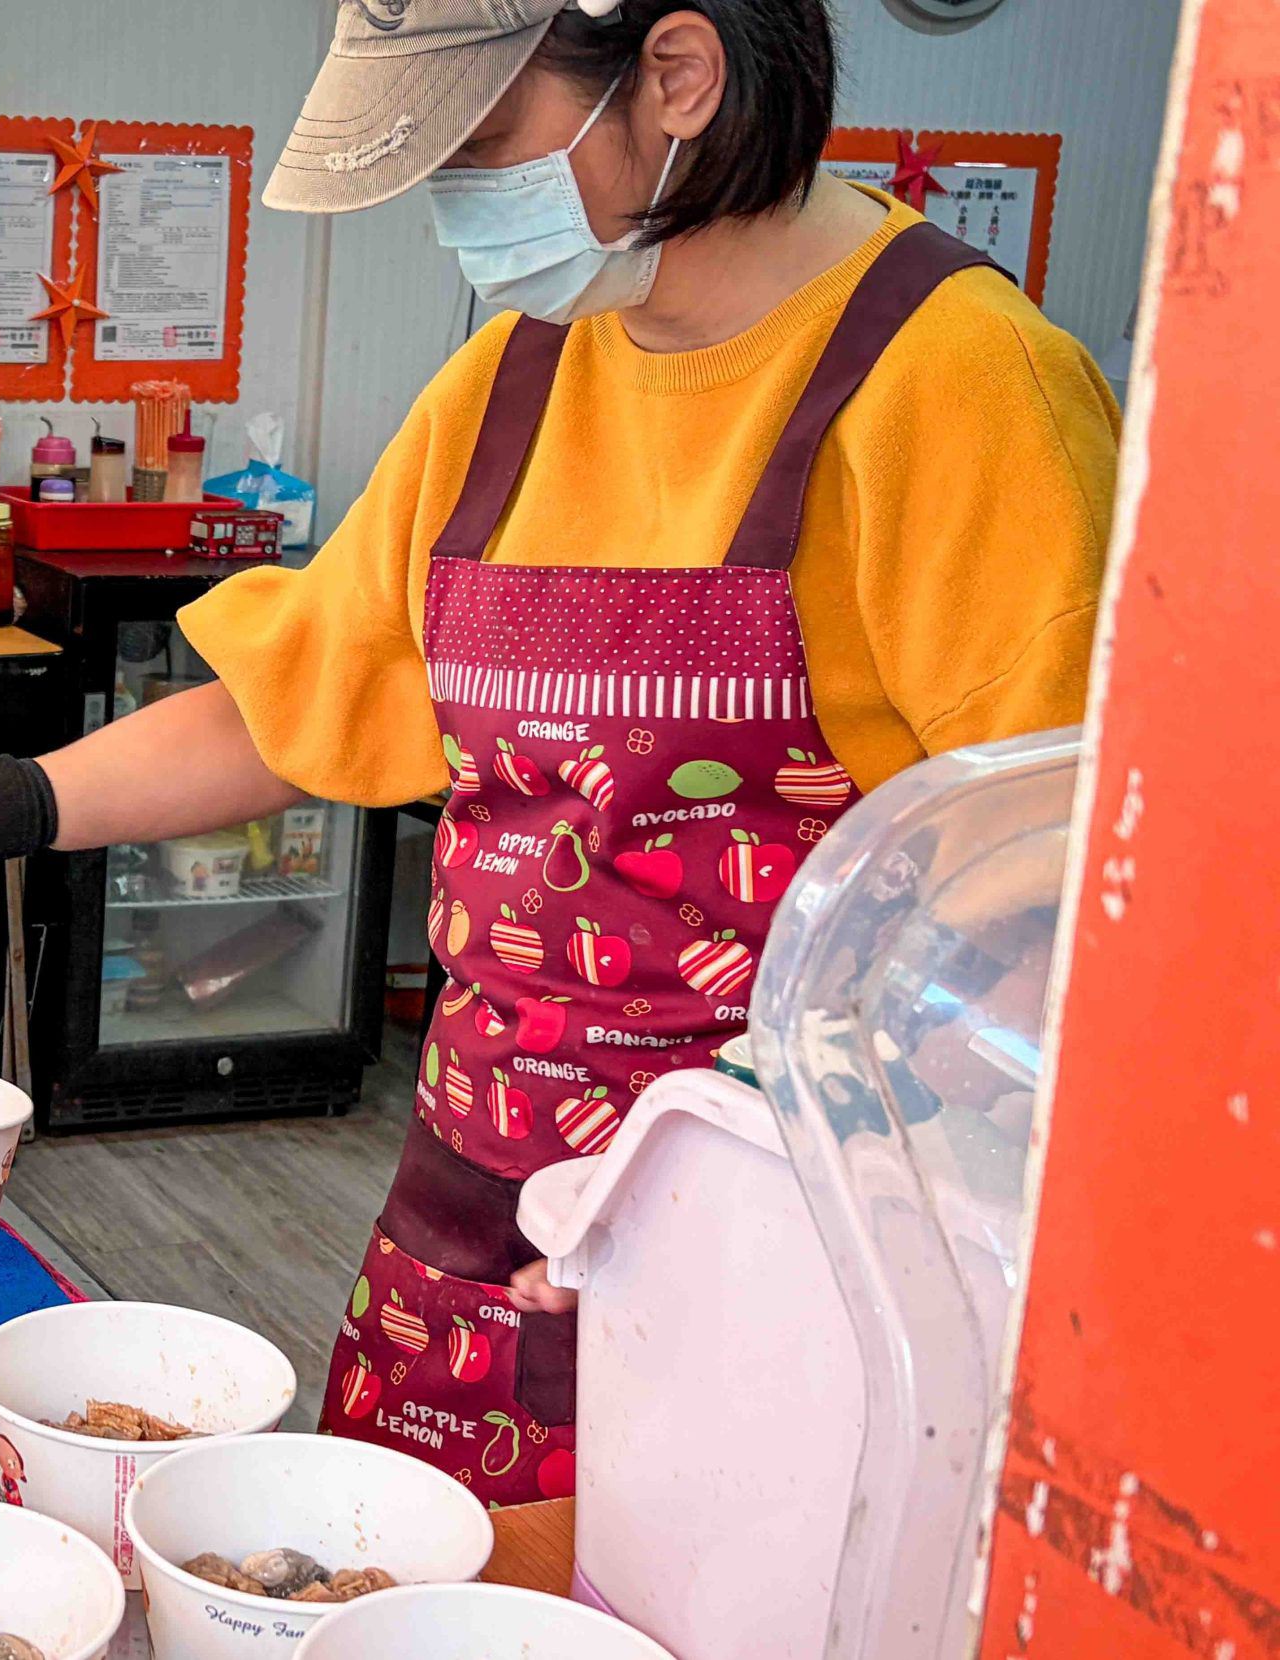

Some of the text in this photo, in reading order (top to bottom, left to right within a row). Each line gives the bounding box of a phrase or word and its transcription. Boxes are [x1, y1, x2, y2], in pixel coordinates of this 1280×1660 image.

[518, 720, 590, 743] ORANGE
[632, 803, 737, 827] AVOCADO
[498, 832, 547, 858] APPLE
[473, 849, 519, 875] LEMON
[513, 1056, 591, 1082] ORANGE
[376, 1407, 443, 1449] LEMON
[403, 1400, 477, 1438] APPLE
[205, 1604, 265, 1637] Happy
